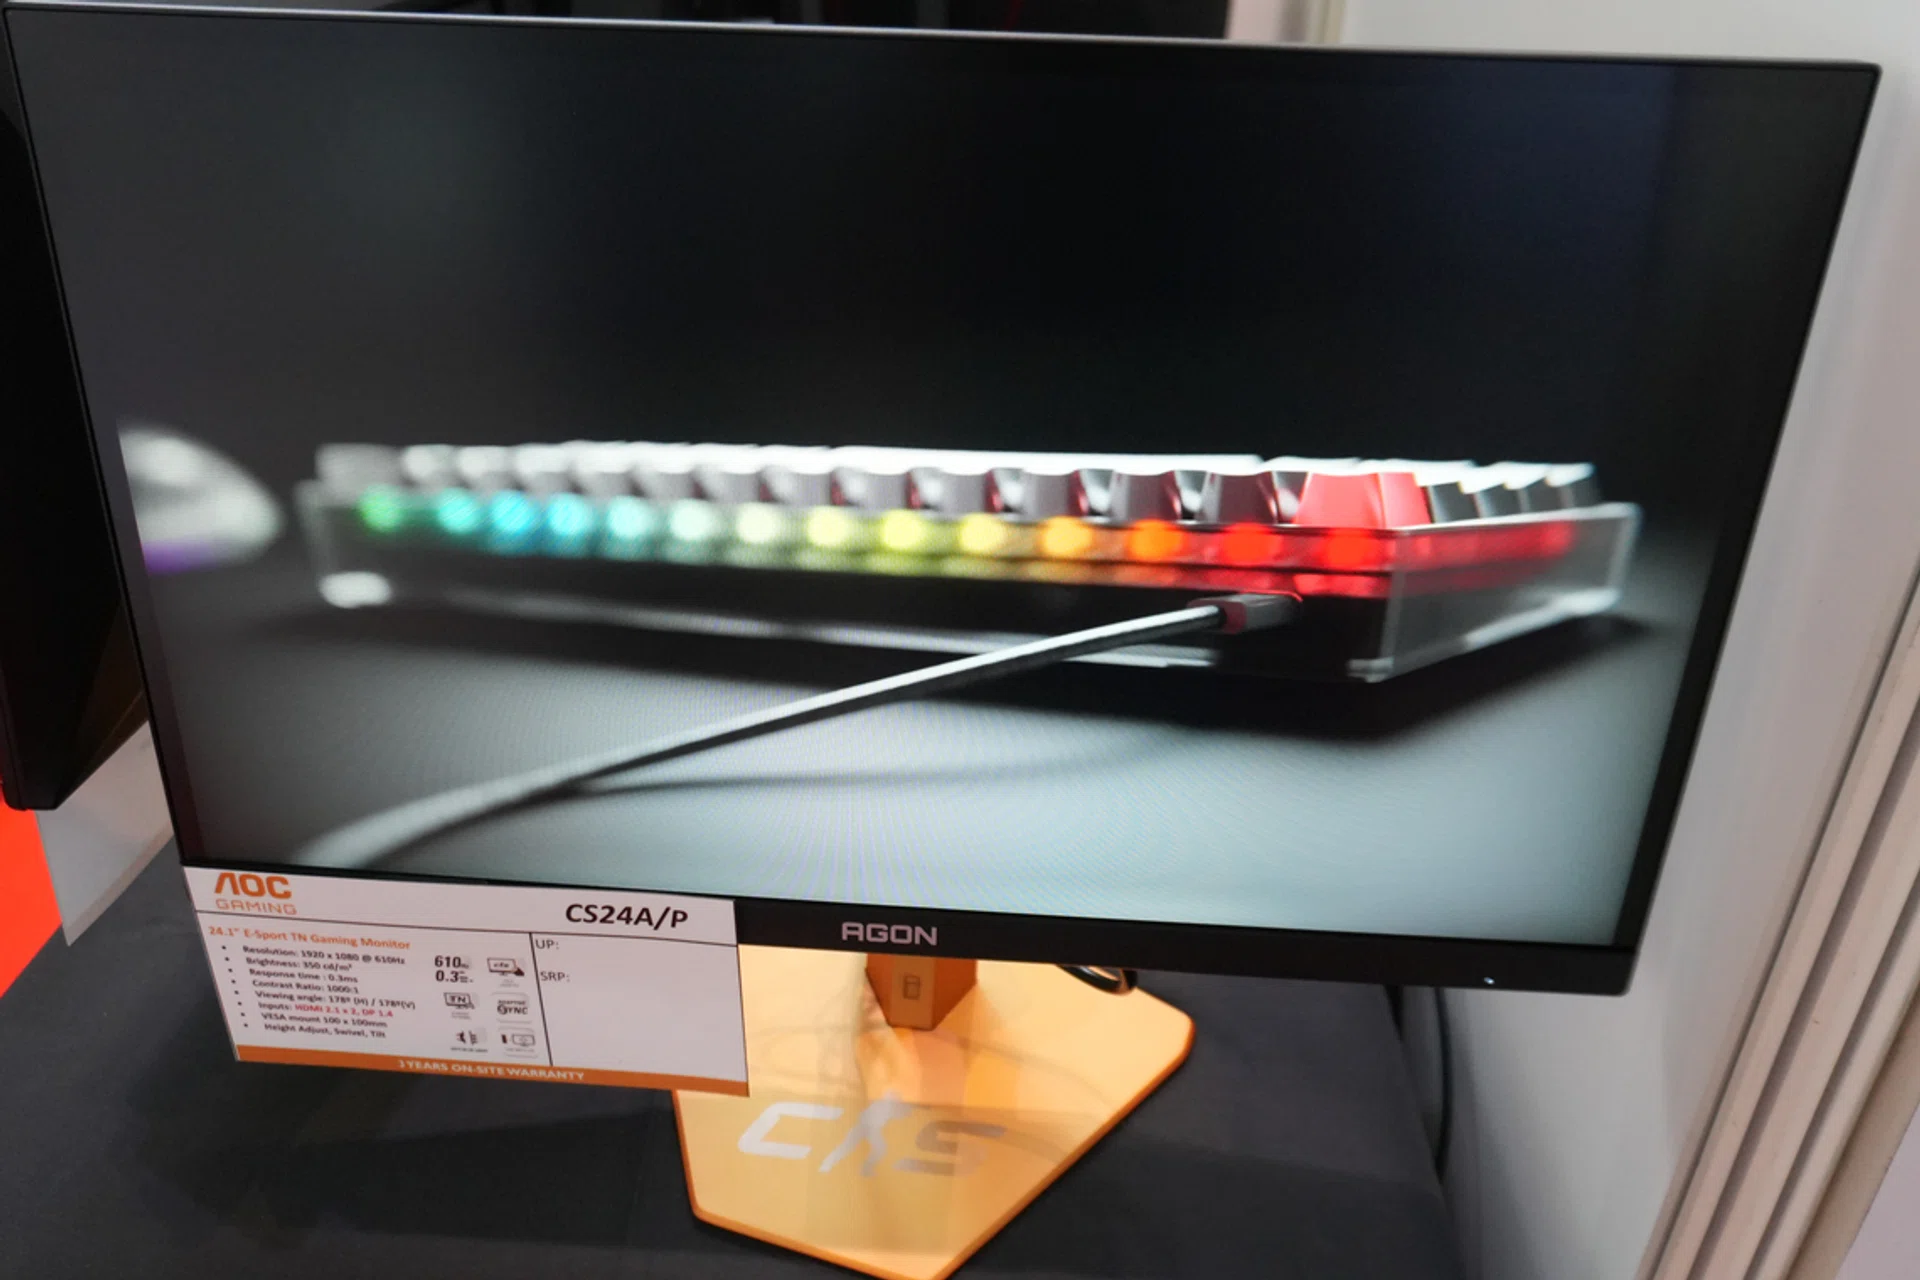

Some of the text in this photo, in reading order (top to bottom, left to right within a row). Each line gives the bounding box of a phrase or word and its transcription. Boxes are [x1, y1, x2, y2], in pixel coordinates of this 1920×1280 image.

[214, 872, 292, 899] AOC
[215, 898, 297, 915] GAMING
[565, 904, 689, 931] CS24A/P
[243, 927, 288, 941] E-Sport
[291, 932, 307, 942] TN
[310, 934, 358, 948] Gaming
[360, 938, 410, 949] Monitor
[841, 922, 937, 946] AGON
[535, 939, 559, 950] UP:
[242, 945, 298, 956] Resolution:
[301, 950, 325, 958] 1920
[335, 952, 359, 960] 1080
[362, 954, 371, 962] @
[374, 955, 405, 964] 610Hz
[246, 957, 300, 967] Brightness:
[303, 961, 320, 969] 350
[249, 968, 295, 978] Response
[328, 974, 358, 983] 0.3ms
[540, 971, 570, 982] SRP:
[252, 980, 293, 989] Contrast
[295, 983, 323, 991] Ratio:
[255, 991, 294, 1001] Viewing
[297, 994, 325, 1002] angle:
[258, 1001, 292, 1010] Inputs:
[295, 1004, 323, 1012] HDMI
[261, 1012, 286, 1021] VESA
[323, 1016, 341, 1024] 100
[351, 1018, 388, 1027] 100mm
[264, 1023, 295, 1033] Height
[370, 1030, 386, 1038] Tilt
[407, 1060, 448, 1071] YEARS
[451, 1063, 504, 1076] ON-SITE
[507, 1067, 585, 1081] WARRANTY
